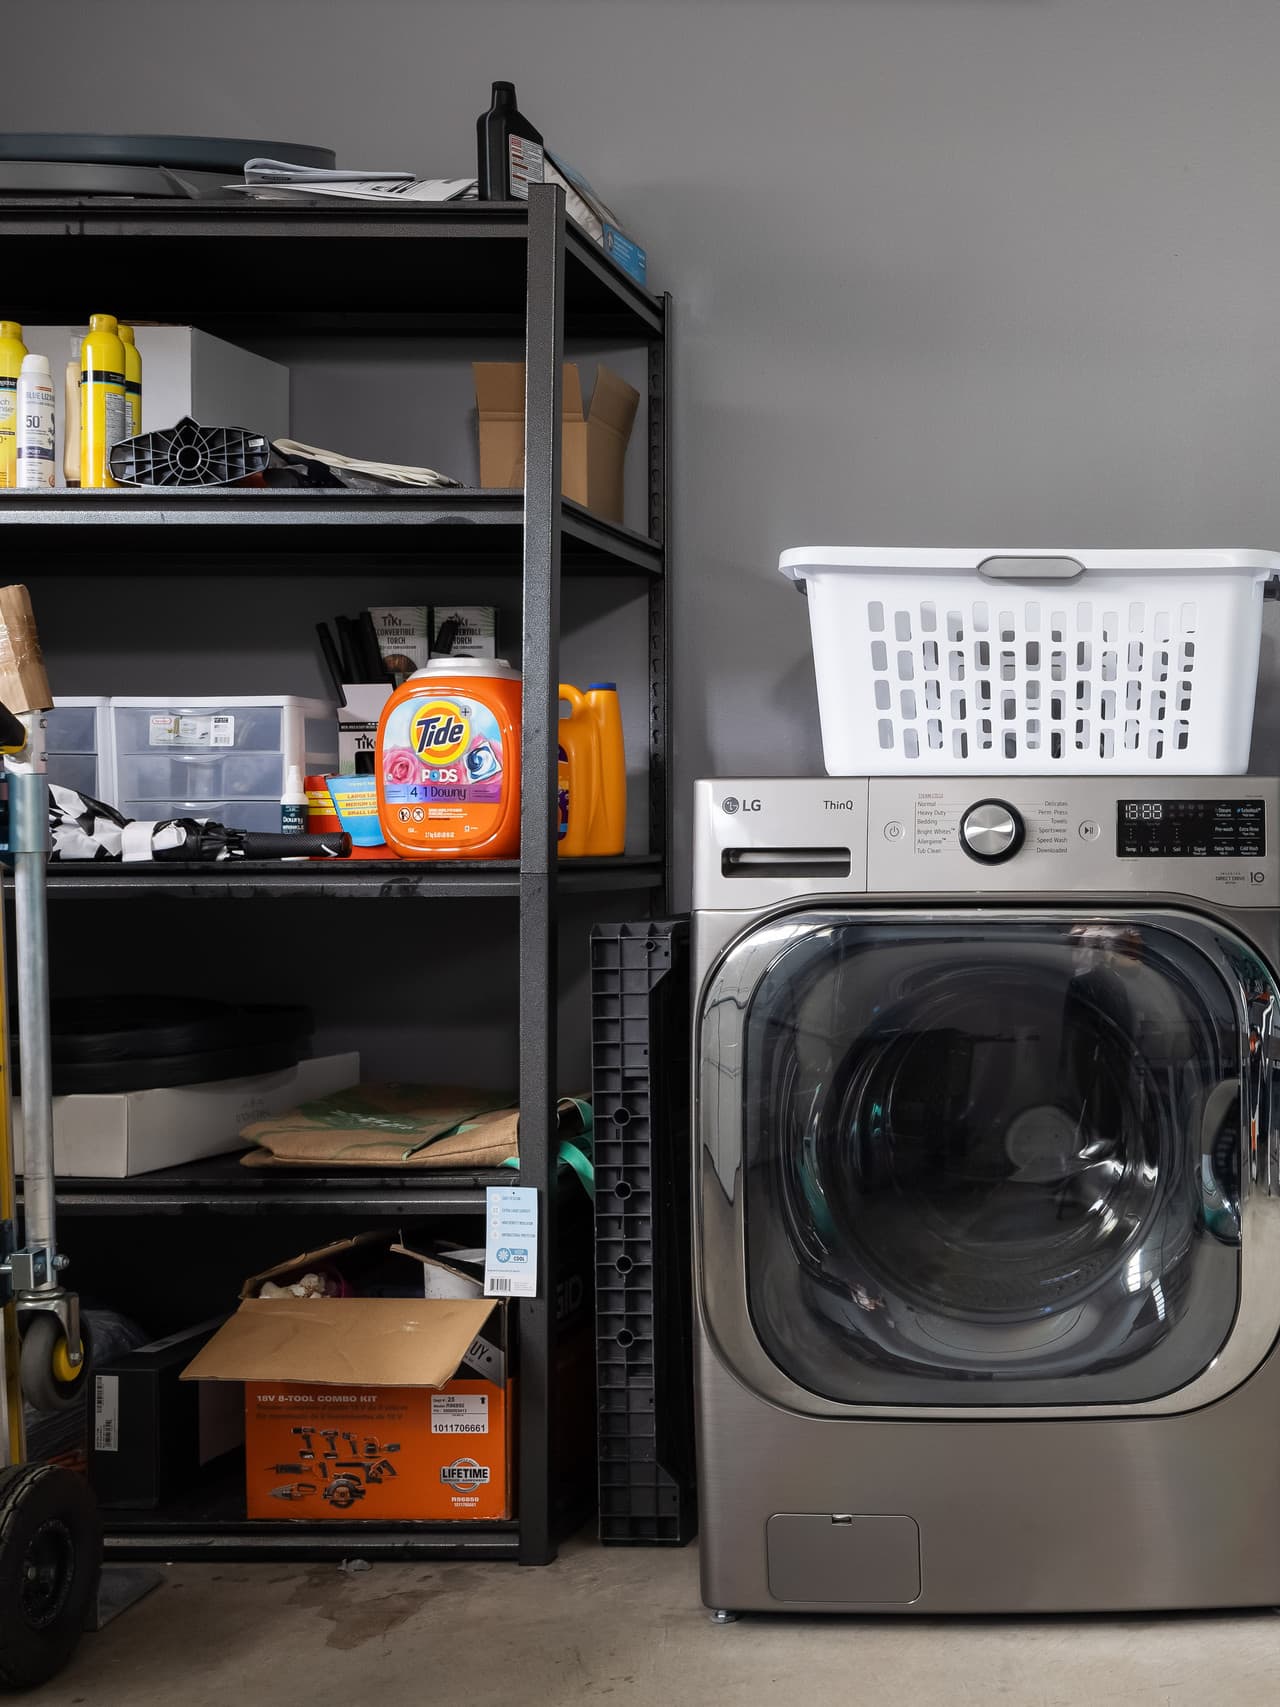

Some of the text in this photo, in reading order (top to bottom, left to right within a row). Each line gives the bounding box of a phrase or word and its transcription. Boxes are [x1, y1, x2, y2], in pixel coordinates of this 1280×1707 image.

[387, 636, 406, 644] TORCH
[416, 714, 465, 754] Tide
[431, 786, 467, 801] Downy
[742, 799, 854, 811] LG ThinQ
[934, 809, 947, 817] Duty
[282, 816, 304, 824] Downy
[433, 1424, 485, 1432] 1011706661
[442, 1468, 489, 1479] LIFETIME
